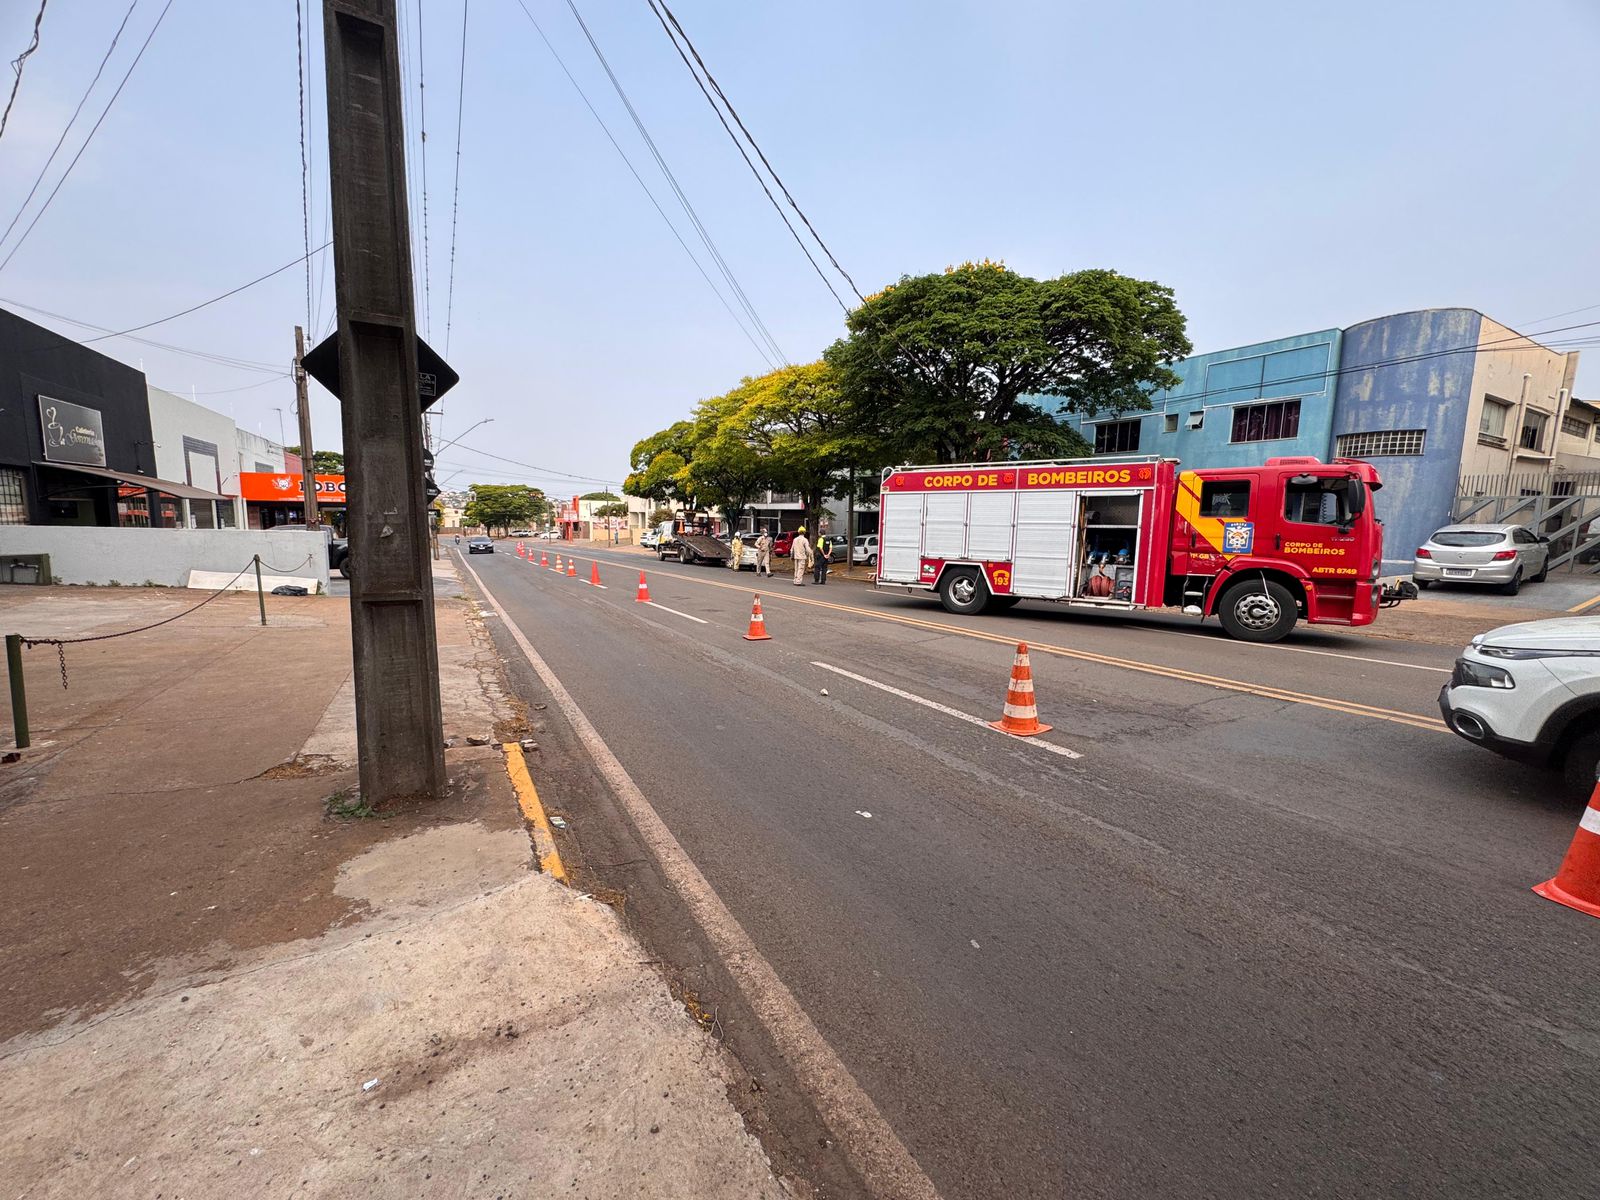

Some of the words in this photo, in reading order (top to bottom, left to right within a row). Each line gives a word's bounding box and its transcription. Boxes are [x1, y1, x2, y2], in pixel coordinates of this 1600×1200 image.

[924, 474, 972, 488] CORPO
[977, 474, 998, 486] DE
[1027, 470, 1131, 485] BOMBEIROS
[1284, 547, 1346, 556] BOMBEIROS
[994, 576, 1009, 586] 193
